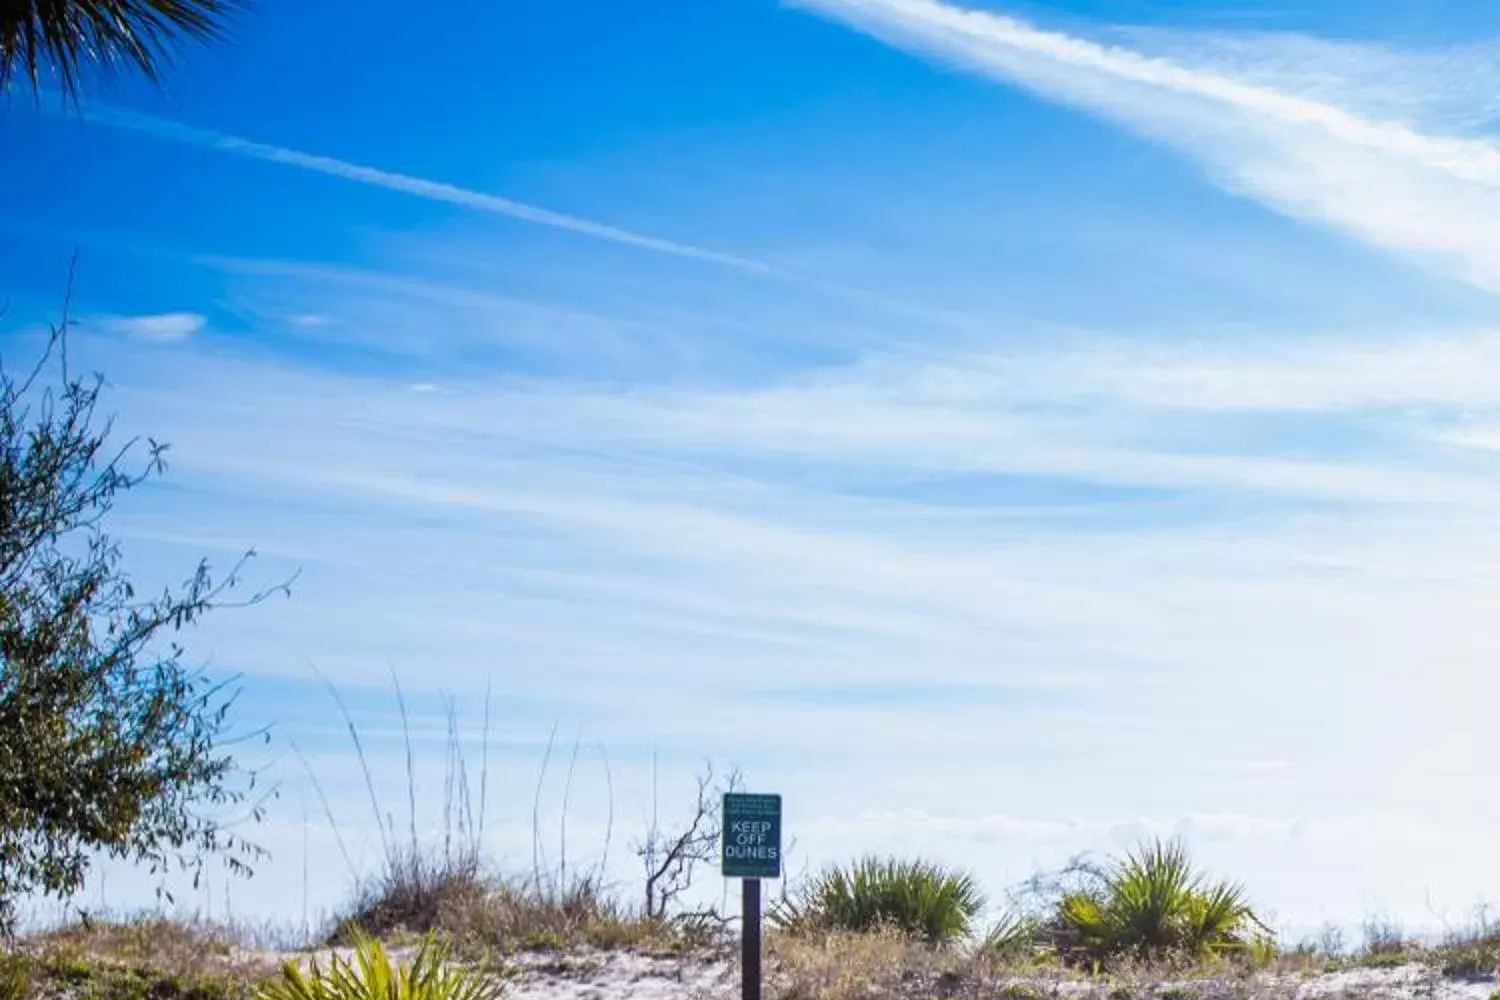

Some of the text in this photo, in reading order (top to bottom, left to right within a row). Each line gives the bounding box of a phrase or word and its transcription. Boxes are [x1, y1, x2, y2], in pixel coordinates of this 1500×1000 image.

[731, 821, 771, 832] KEEP
[737, 833, 766, 845] OFF
[725, 846, 777, 858] DUNES
